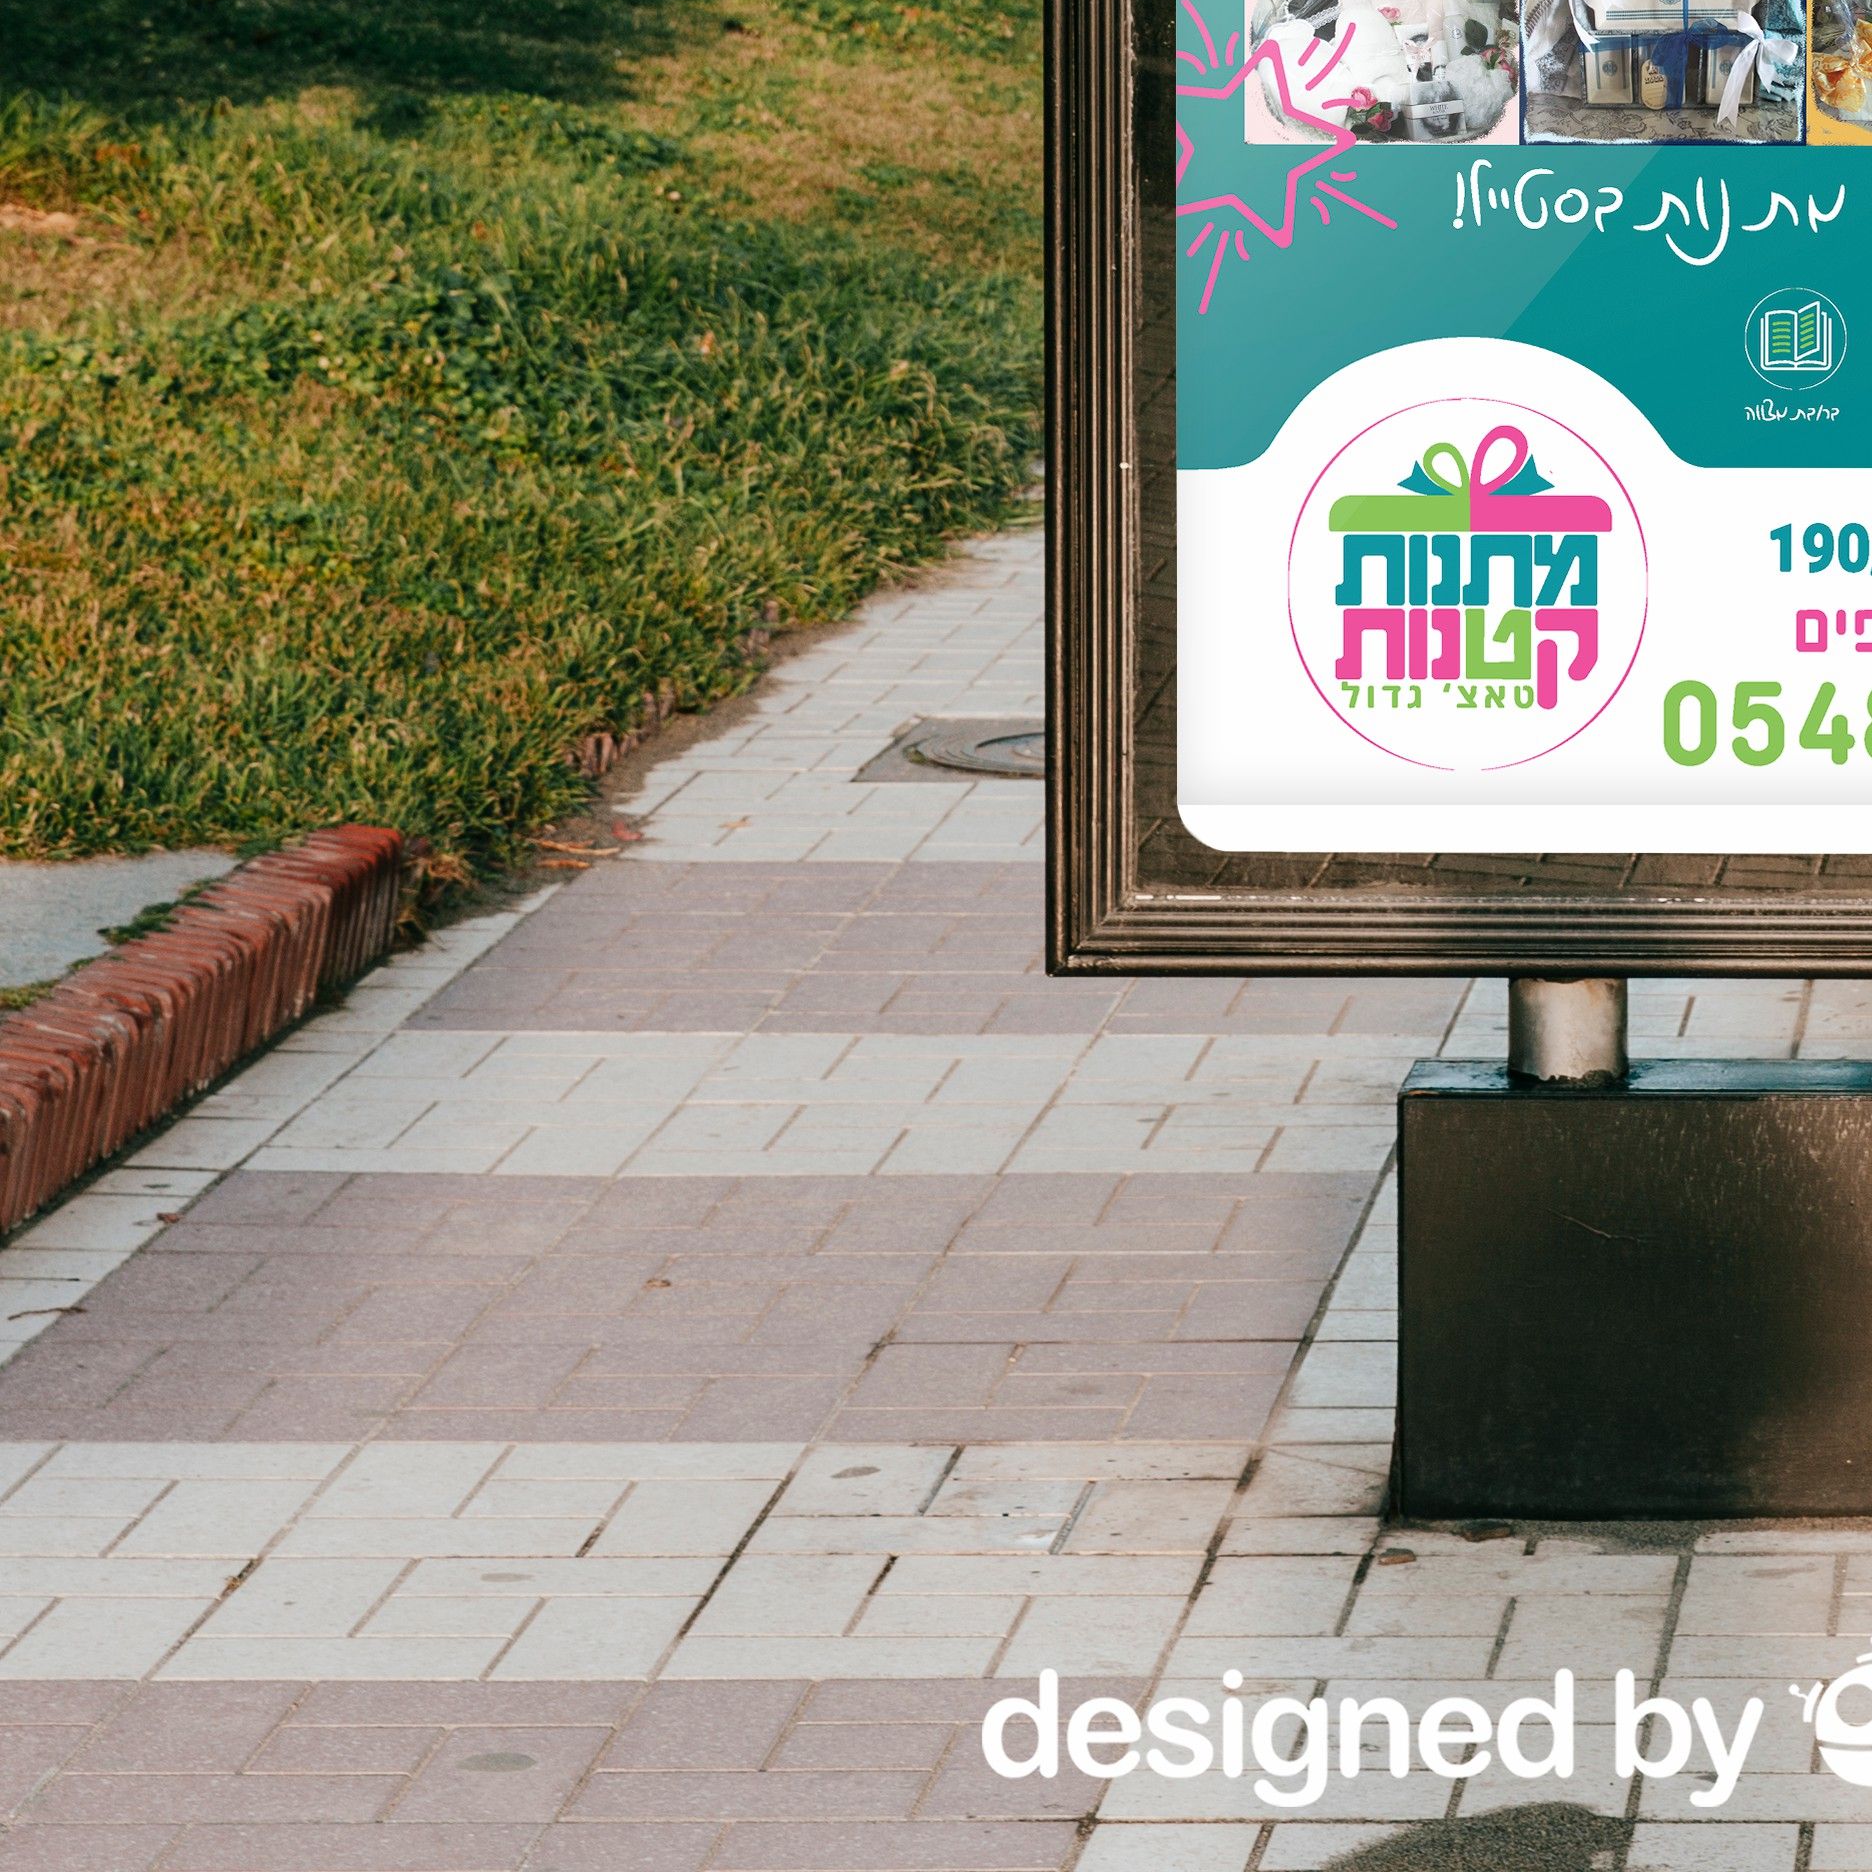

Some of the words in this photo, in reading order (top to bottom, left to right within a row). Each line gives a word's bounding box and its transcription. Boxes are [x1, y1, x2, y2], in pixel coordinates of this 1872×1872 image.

[1453, 159, 1623, 232] בסטייל!
[1335, 534, 1599, 608] מתנות
[1335, 608, 1599, 710] קטנות
[1341, 682, 1422, 709] גדול
